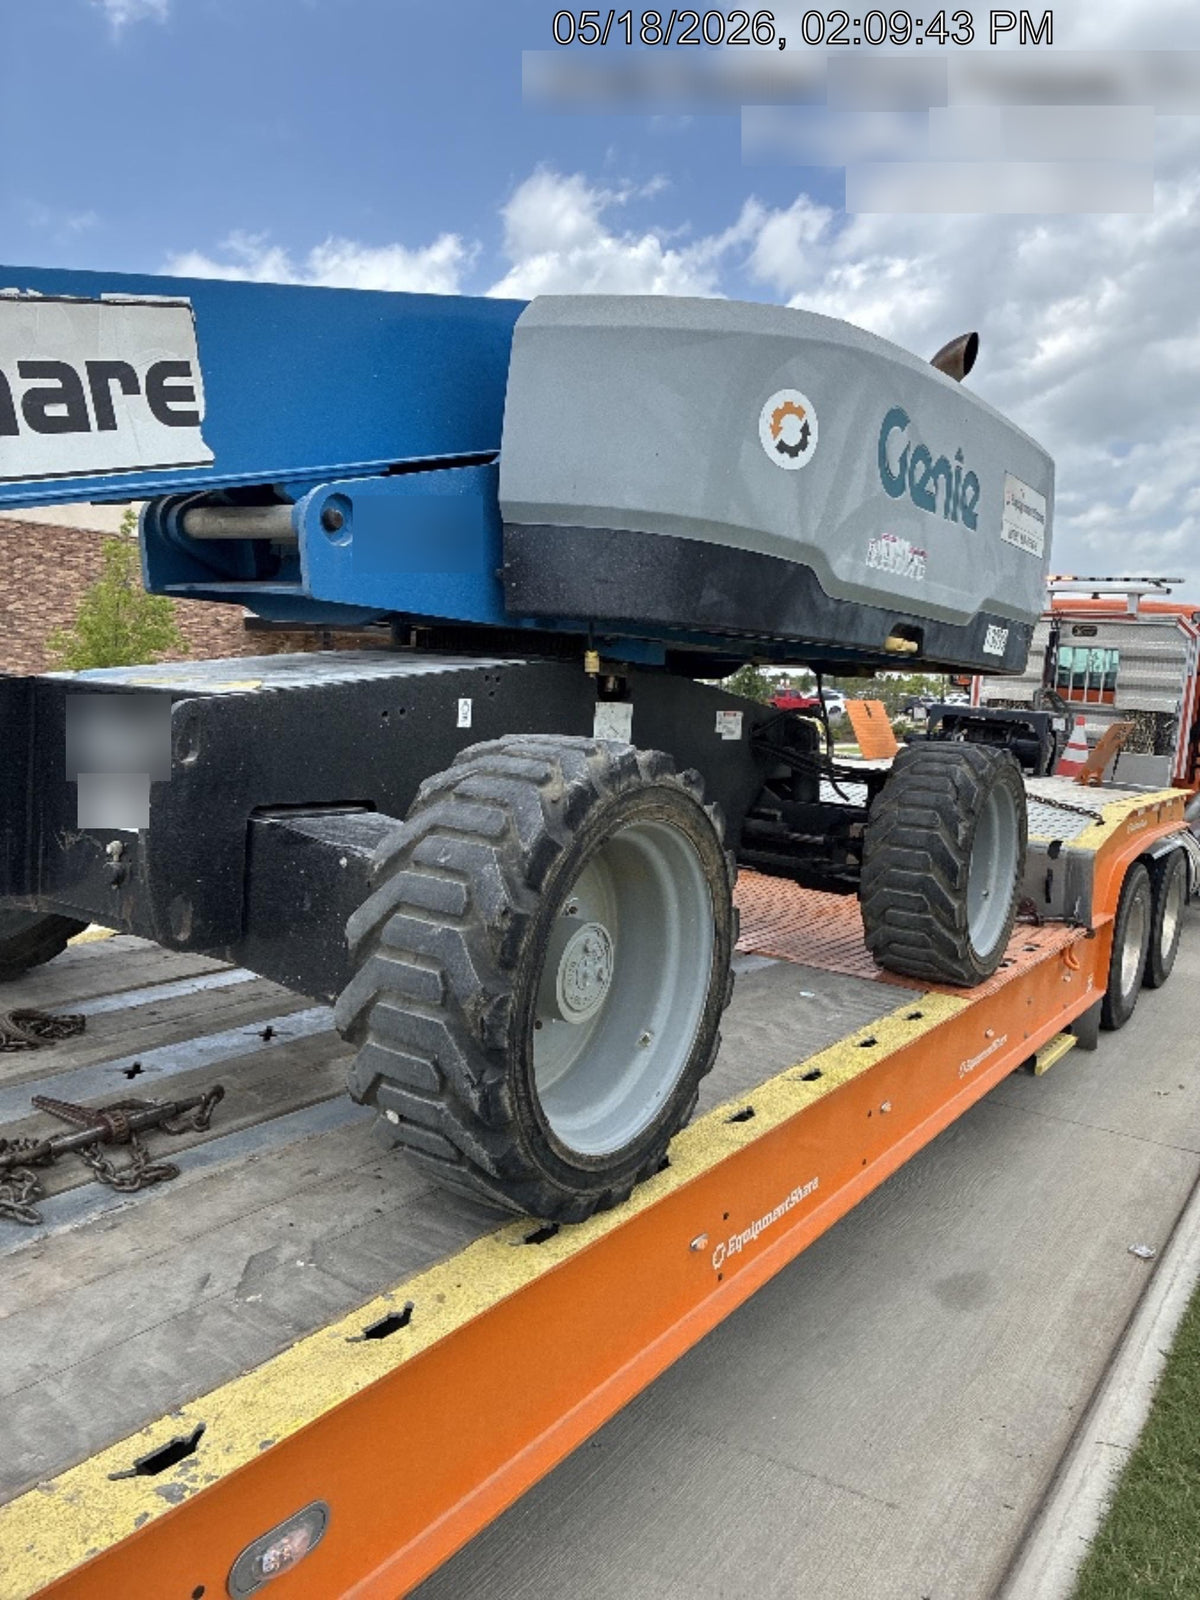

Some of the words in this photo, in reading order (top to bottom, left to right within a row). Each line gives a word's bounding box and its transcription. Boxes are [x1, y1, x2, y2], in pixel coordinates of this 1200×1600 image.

[0, 361, 200, 436] are
[878, 405, 980, 532] Genie
[727, 1176, 819, 1258] EquipmentShare
